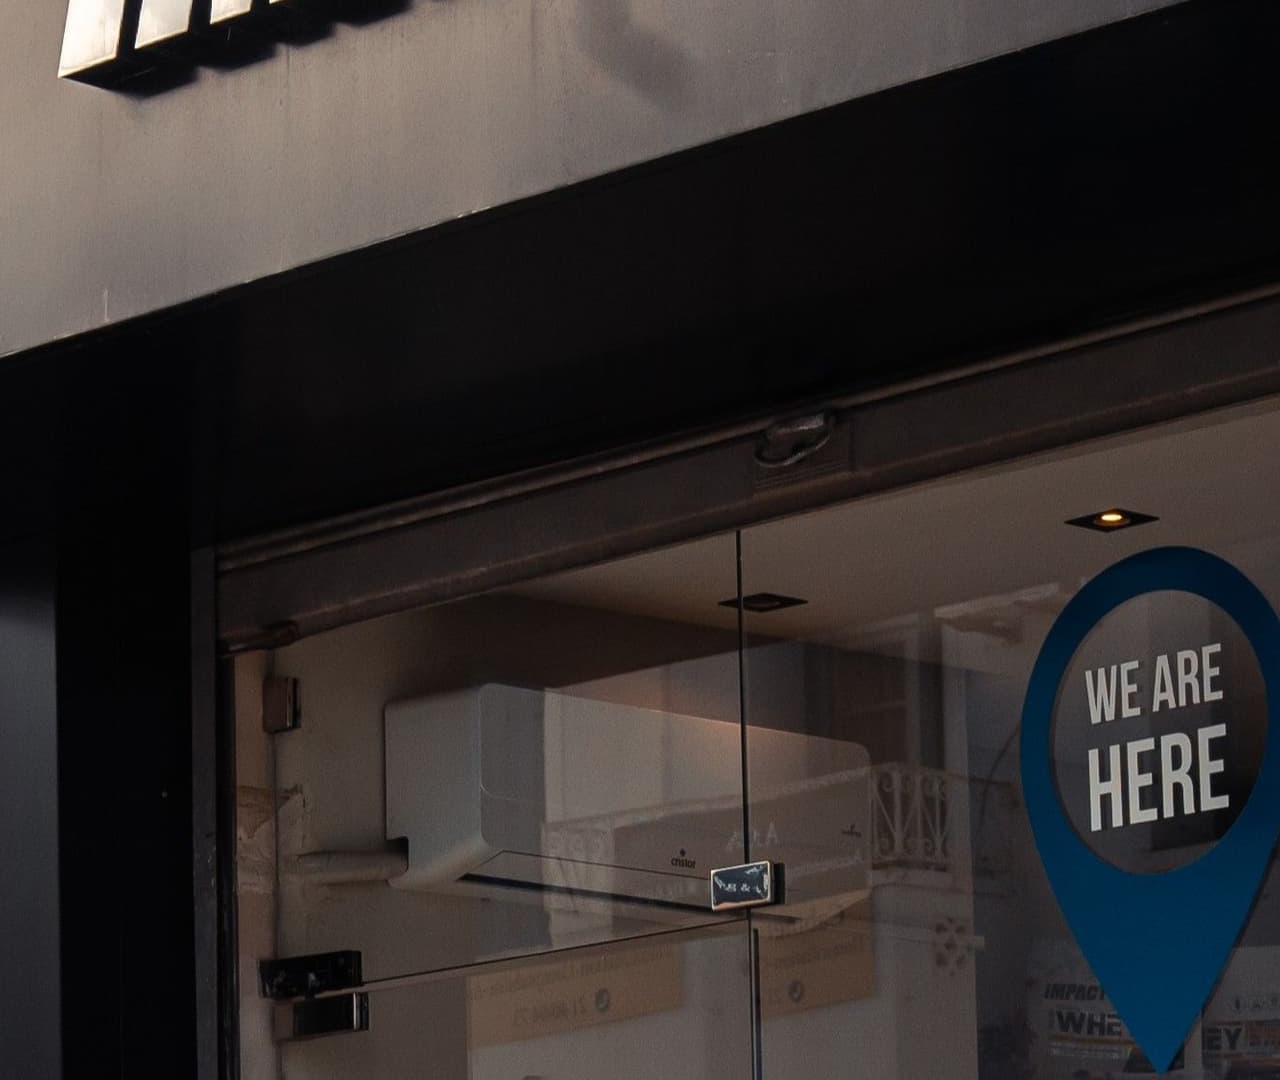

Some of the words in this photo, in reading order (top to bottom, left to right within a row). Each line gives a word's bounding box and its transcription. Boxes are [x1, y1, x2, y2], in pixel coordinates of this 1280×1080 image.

[1084, 660, 1142, 725] WE
[1152, 642, 1223, 713] ARE
[1087, 723, 1230, 832] HERE
[1056, 1010, 1122, 1036] WHE
